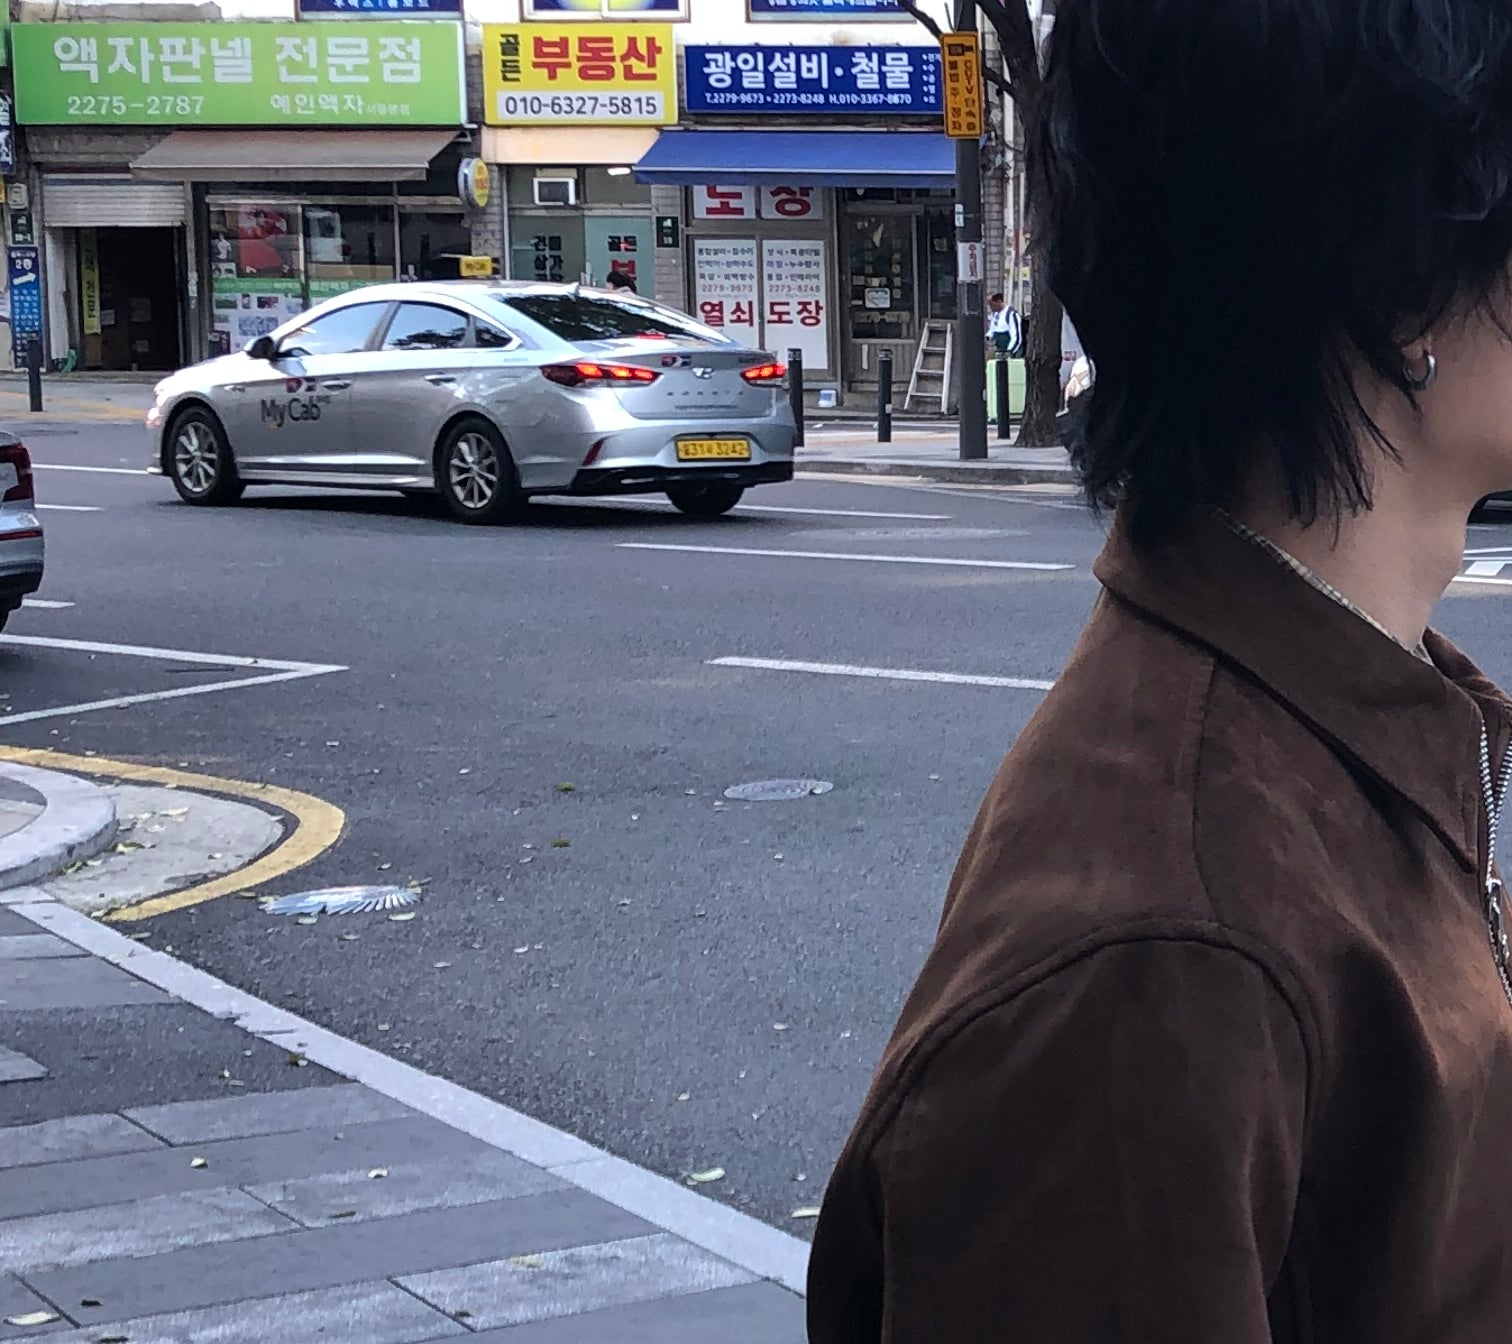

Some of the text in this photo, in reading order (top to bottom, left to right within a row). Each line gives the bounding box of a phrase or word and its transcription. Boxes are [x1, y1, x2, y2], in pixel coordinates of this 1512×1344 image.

[53, 36, 422, 84] 액자판넬 전문점
[500, 33, 521, 83] 골든
[532, 35, 663, 81] 부동산
[67, 95, 205, 116] 2275-2787
[505, 96, 658, 115] 010-6327-5815
[700, 300, 823, 327] 열쇠 도장
[261, 396, 321, 428] MyCab
